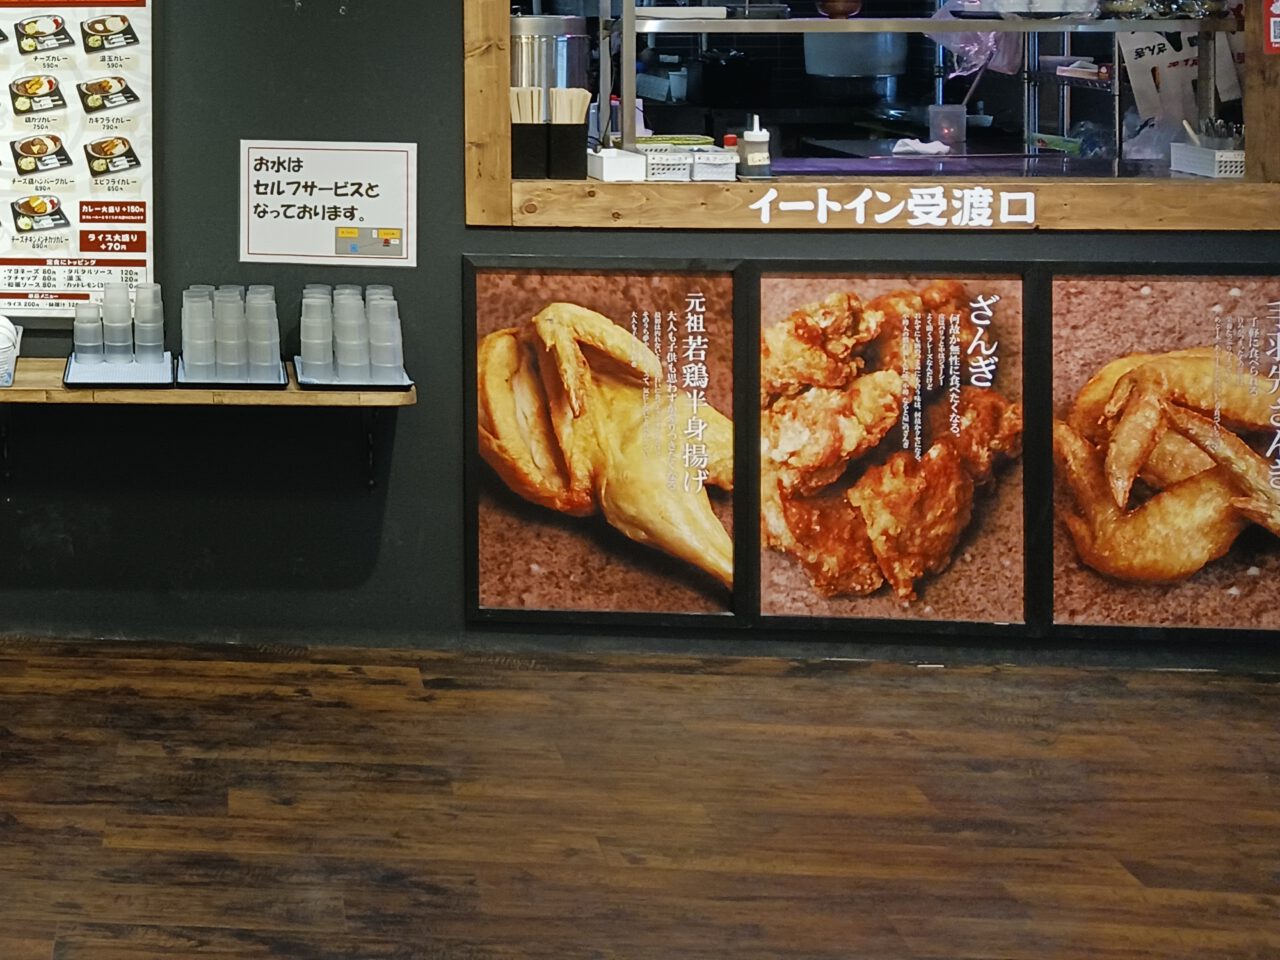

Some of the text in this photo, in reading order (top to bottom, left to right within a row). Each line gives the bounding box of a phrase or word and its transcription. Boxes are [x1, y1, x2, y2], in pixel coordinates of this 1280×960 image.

[253, 156, 303, 173] お水は
[253, 180, 380, 198] セルフサービスと
[82, 205, 120, 213] カレー大盛り
[253, 202, 365, 222] なっております。
[748, 186, 1036, 227] イートイン受渡口
[88, 234, 137, 242] ライス大盛り
[967, 294, 1001, 387] ざんぎ
[682, 293, 709, 494] 元祖若鶏半身揚げ
